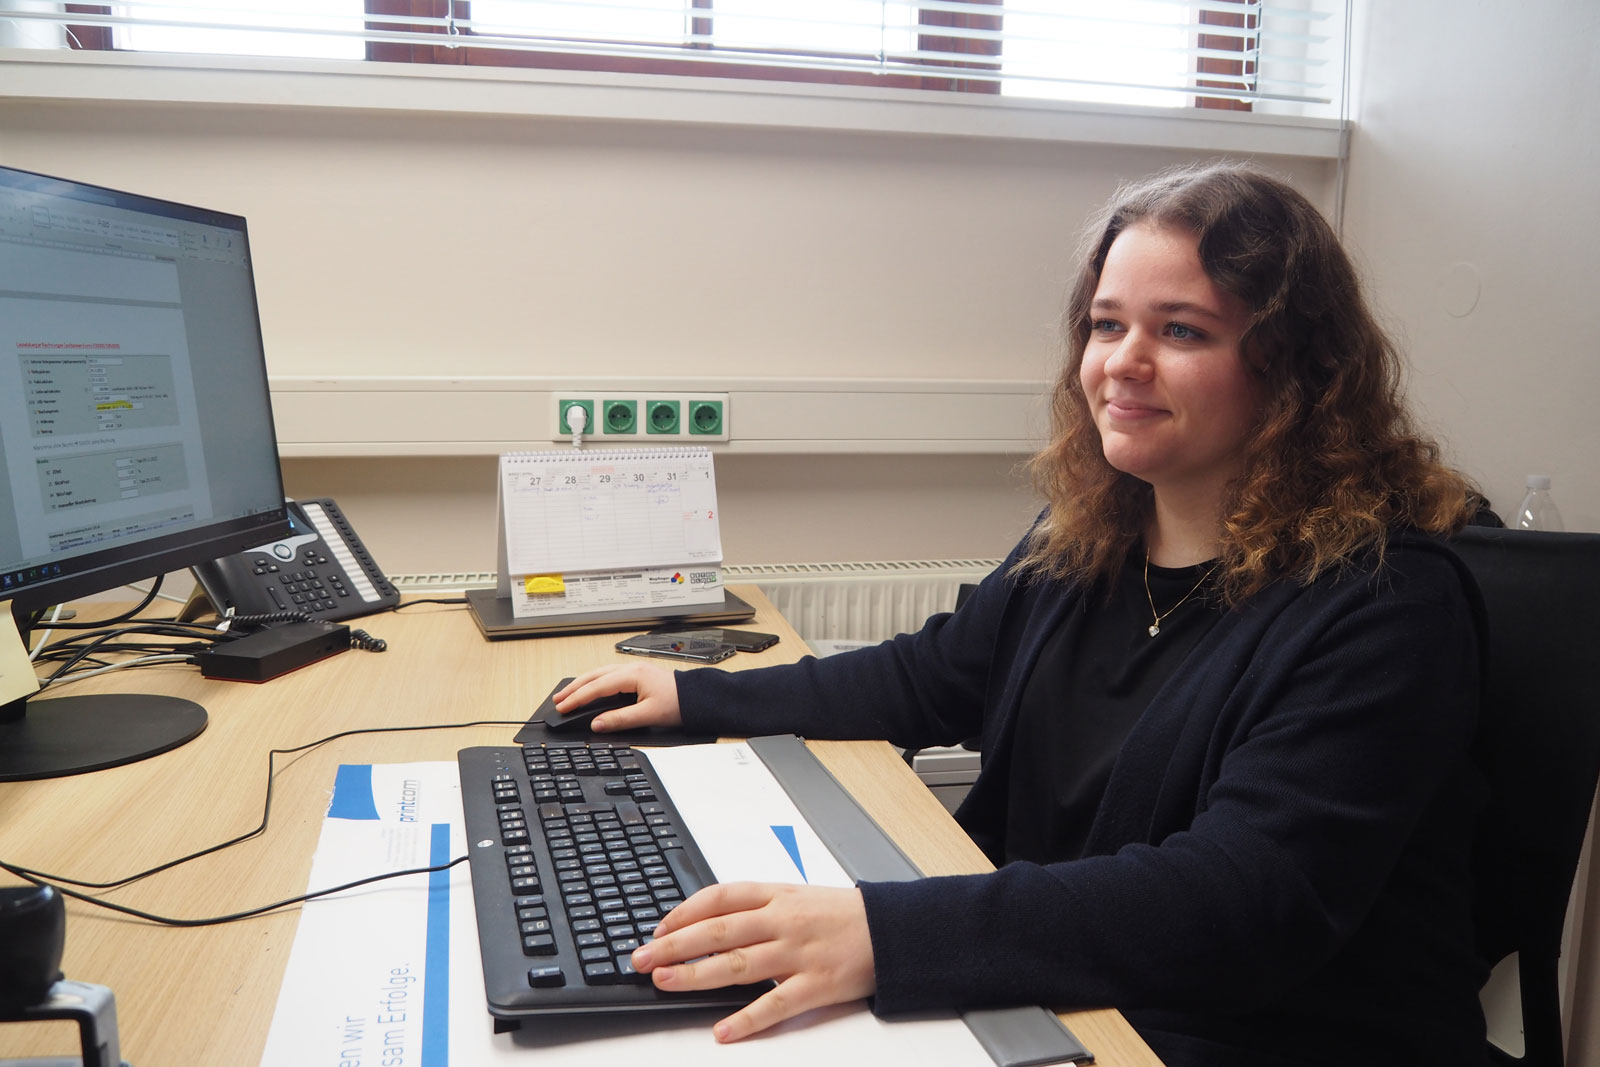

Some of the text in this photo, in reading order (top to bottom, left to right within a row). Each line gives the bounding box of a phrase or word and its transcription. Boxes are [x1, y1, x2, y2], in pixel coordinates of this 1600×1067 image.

[530, 471, 709, 486] 27 28 29 30 31 1
[707, 511, 713, 519] 2
[396, 779, 418, 822] printcom
[377, 962, 417, 1024] Erfolge.
[336, 1015, 366, 1044] wir
